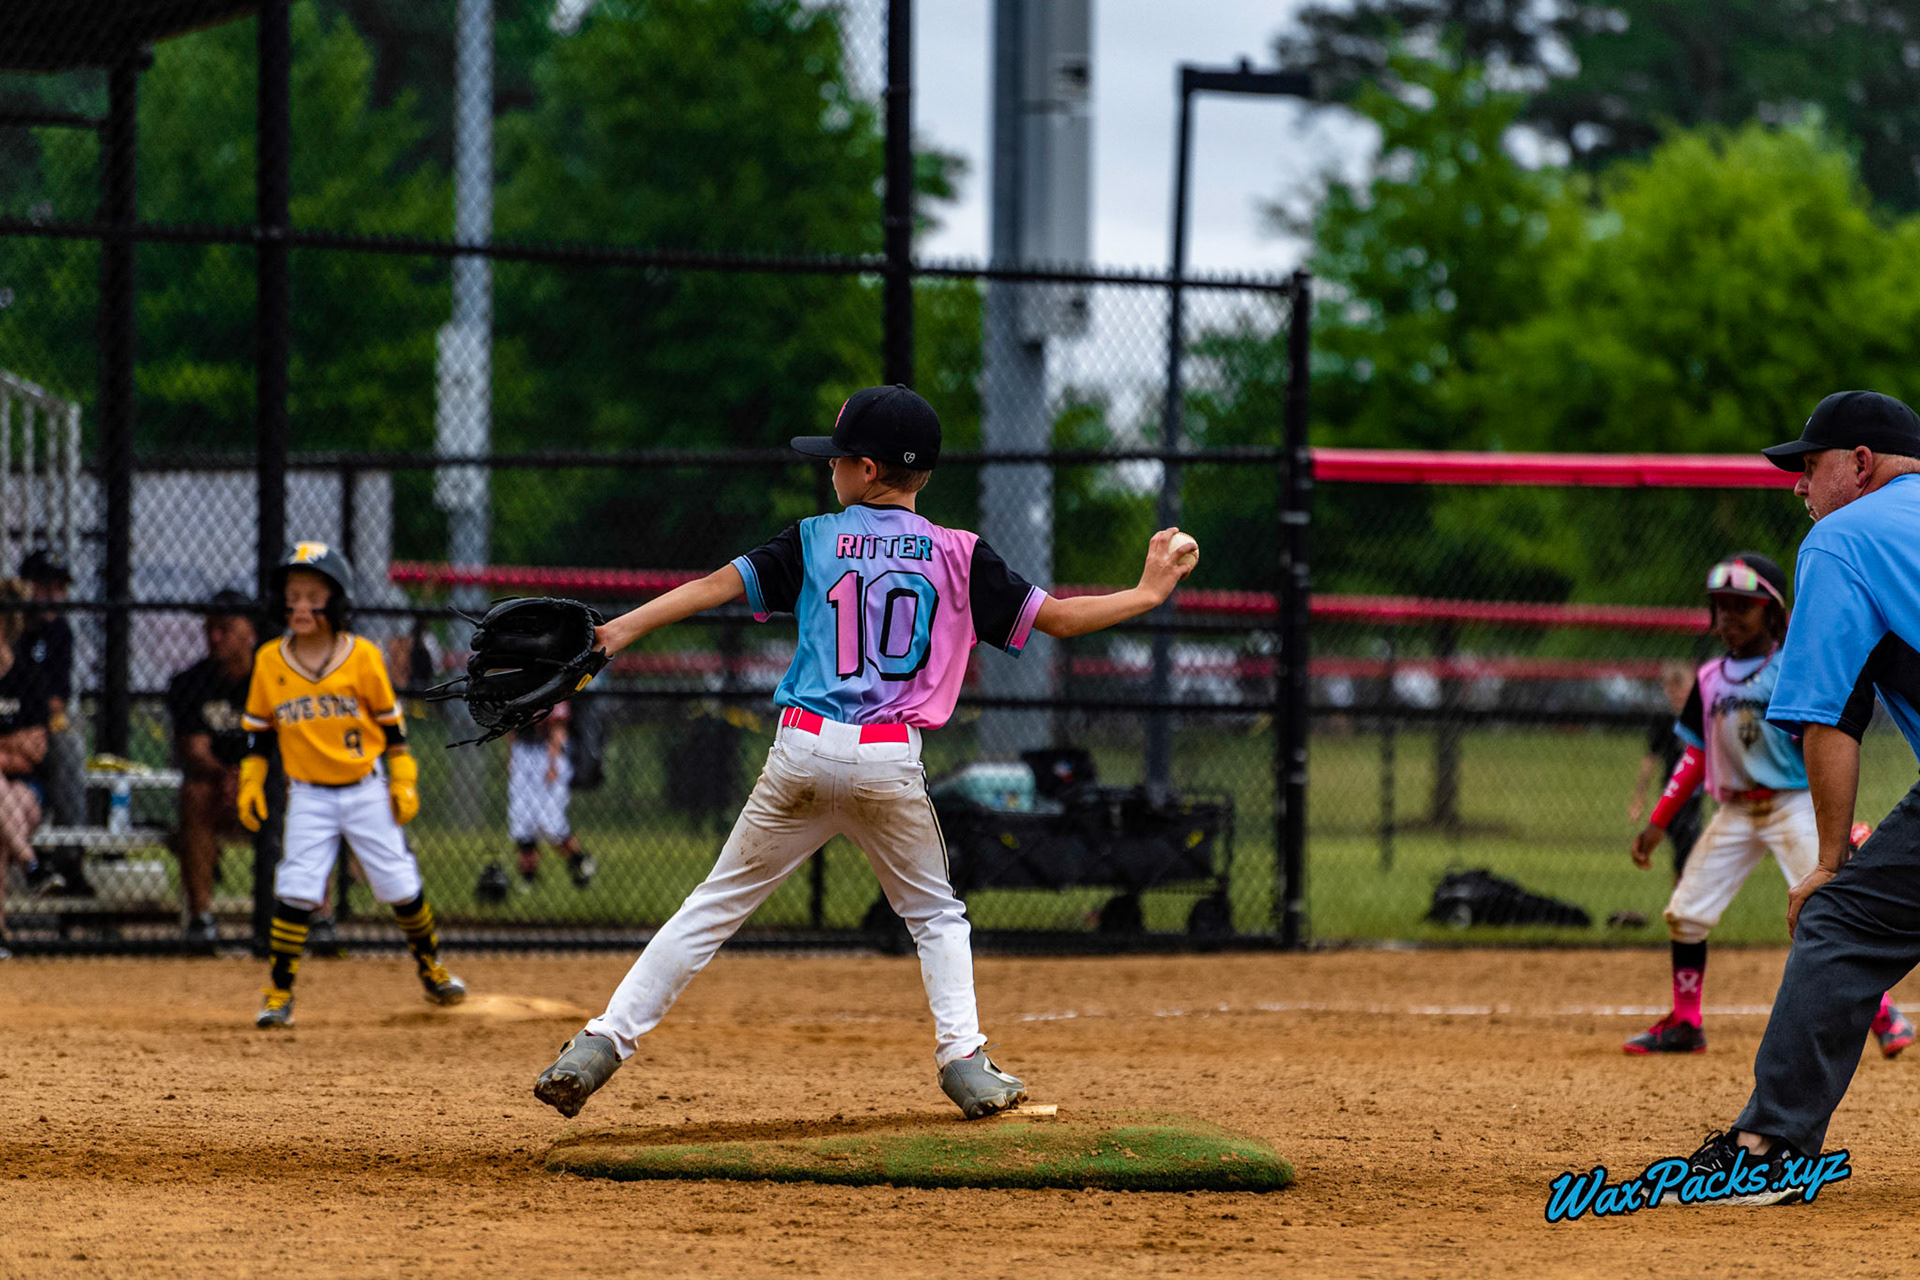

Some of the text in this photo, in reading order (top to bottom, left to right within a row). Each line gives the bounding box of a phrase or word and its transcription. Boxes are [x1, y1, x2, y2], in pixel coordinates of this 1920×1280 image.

[836, 533, 932, 561] RITTER
[827, 570, 940, 681] 10
[343, 729, 365, 758] 9
